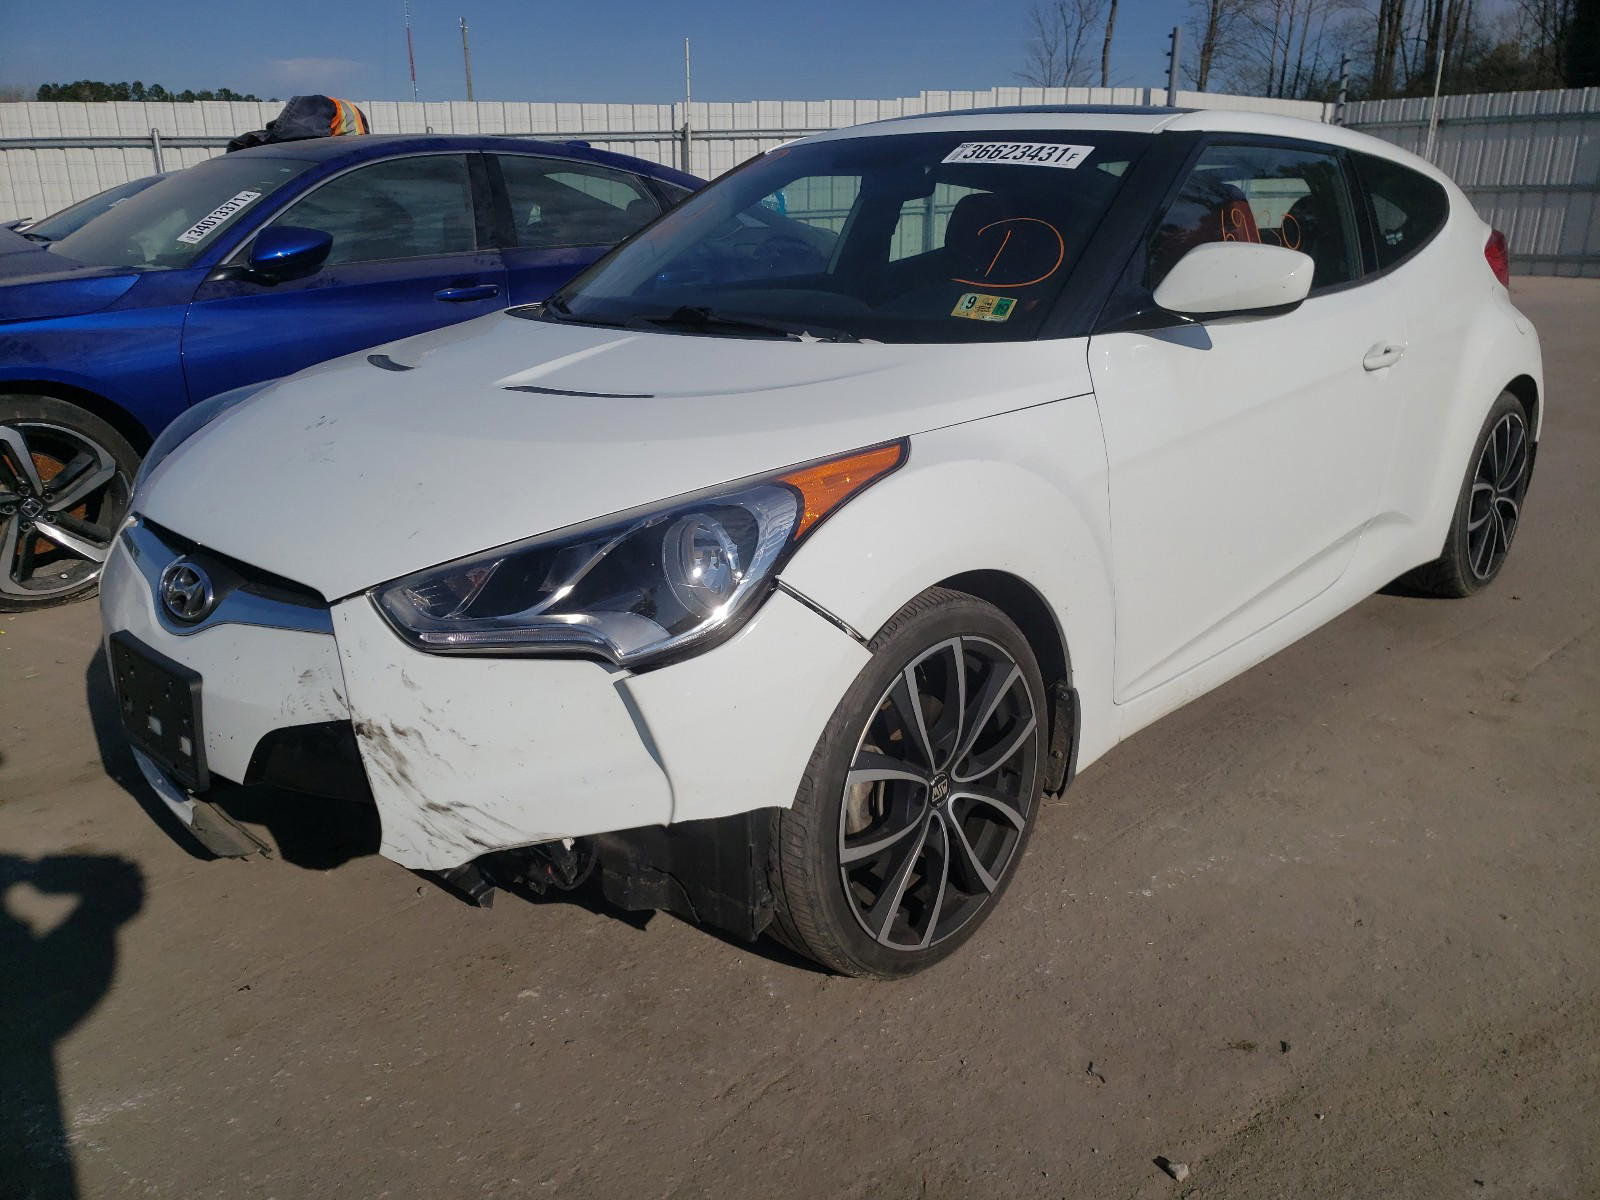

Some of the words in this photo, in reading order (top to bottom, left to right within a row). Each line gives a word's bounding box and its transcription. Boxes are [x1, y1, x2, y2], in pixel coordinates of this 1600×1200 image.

[962, 144, 1071, 163] 36623431
[1066, 153, 1079, 162] F
[187, 197, 248, 237] 34013371
[966, 296, 977, 309] 9
[931, 778, 948, 803] MSW
